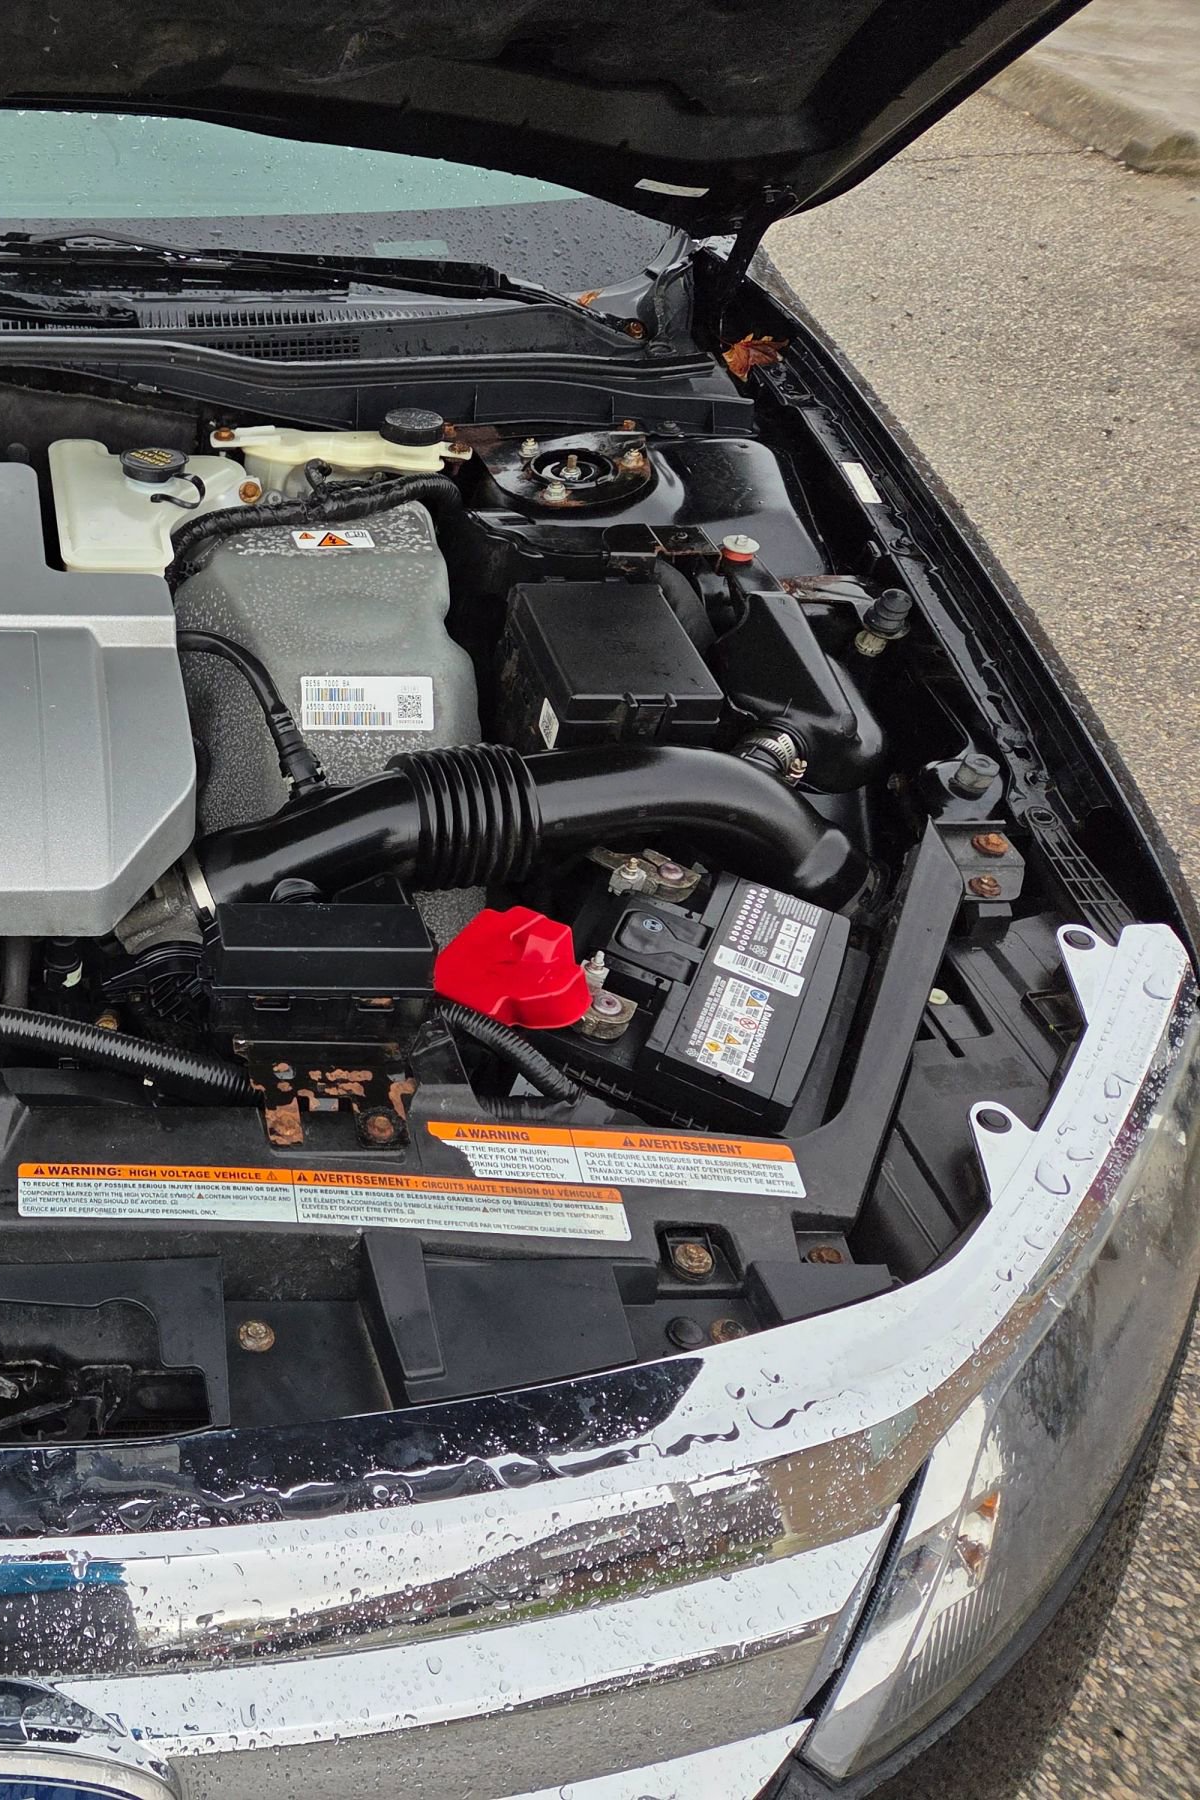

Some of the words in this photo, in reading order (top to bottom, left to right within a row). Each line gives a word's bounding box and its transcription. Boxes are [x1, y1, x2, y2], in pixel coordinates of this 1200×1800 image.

[468, 1128, 530, 1141] WARNING
[636, 1137, 744, 1155] AVERTISSEMENT
[535, 1156, 569, 1164] IGNITION
[583, 1151, 606, 1159] POUR
[606, 1151, 641, 1161] RÉDUIRE
[657, 1155, 692, 1164] RISQUES
[751, 1162, 783, 1171] RETIRER
[47, 1164, 121, 1177] WARNING:
[128, 1169, 156, 1177] HIGH
[160, 1168, 210, 1178] VOLTAGE
[214, 1171, 261, 1180] VEHICLE
[596, 1158, 614, 1167] CLÉ
[626, 1160, 675, 1171] L'ALLUMAGE
[675, 1164, 700, 1172] AVANT
[701, 1166, 768, 1178] D'ENTREPRENDRE
[768, 1171, 784, 1179] DES
[312, 1172, 411, 1187] AVERTISSEMENT
[420, 1180, 464, 1190] CIRCUITS
[465, 1183, 497, 1192] HAUTE
[500, 1185, 539, 1194] TENSION
[556, 1187, 602, 1198] VÉHICULE
[601, 1174, 636, 1183] MARCHE
[39, 1196, 87, 1204] TEMPERATURES
[406, 1193, 444, 1201] BLESSURES
